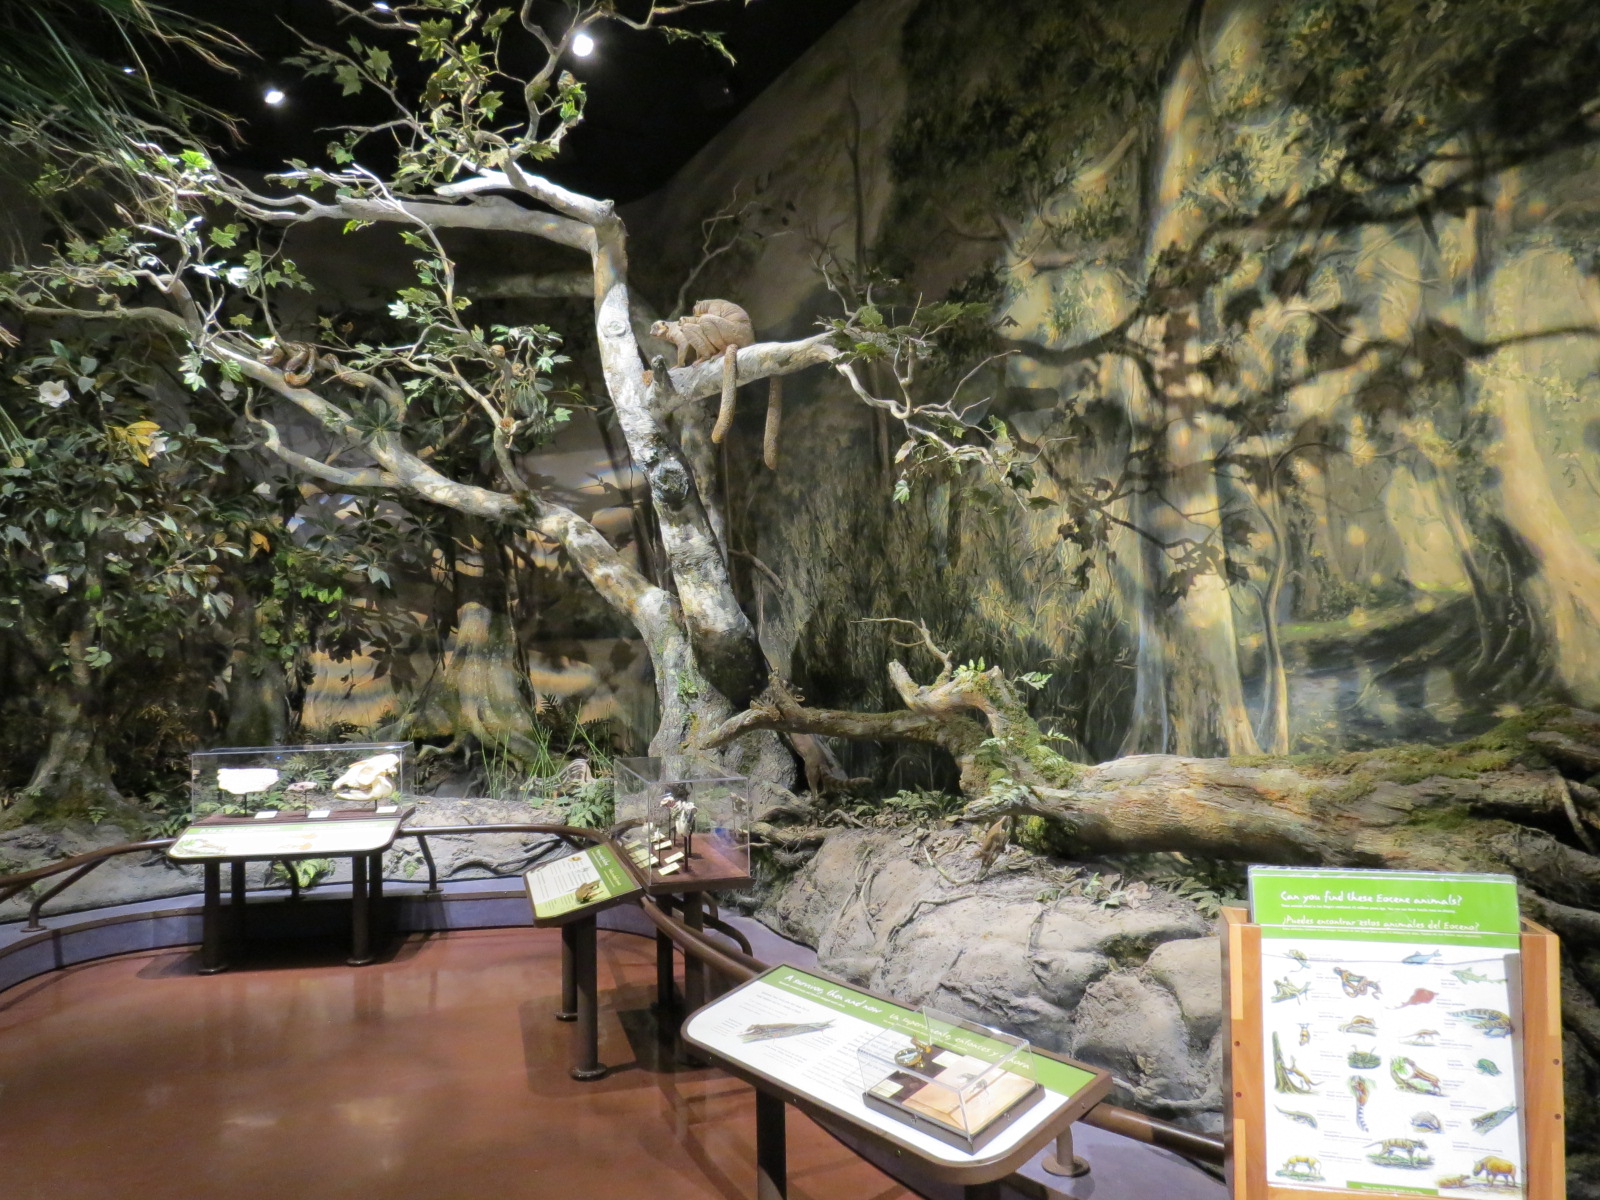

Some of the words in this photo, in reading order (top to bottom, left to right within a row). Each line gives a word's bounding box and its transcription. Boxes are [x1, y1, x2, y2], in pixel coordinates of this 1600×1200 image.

[1280, 890, 1299, 901] Can
[1302, 893, 1320, 904] you
[1324, 890, 1344, 903] find
[1347, 891, 1373, 902] these
[1376, 893, 1411, 904] Eocene
[1413, 894, 1463, 906] animals?
[1316, 917, 1356, 926] encontrar
[1359, 918, 1380, 927] estos
[1383, 919, 1425, 929] animales
[1427, 919, 1441, 929] del
[1443, 921, 1480, 932] Eoceno?
[783, 974, 793, 982] A
[826, 988, 844, 1001] then
[844, 995, 867, 1007] and
[862, 1004, 884, 1014] now
